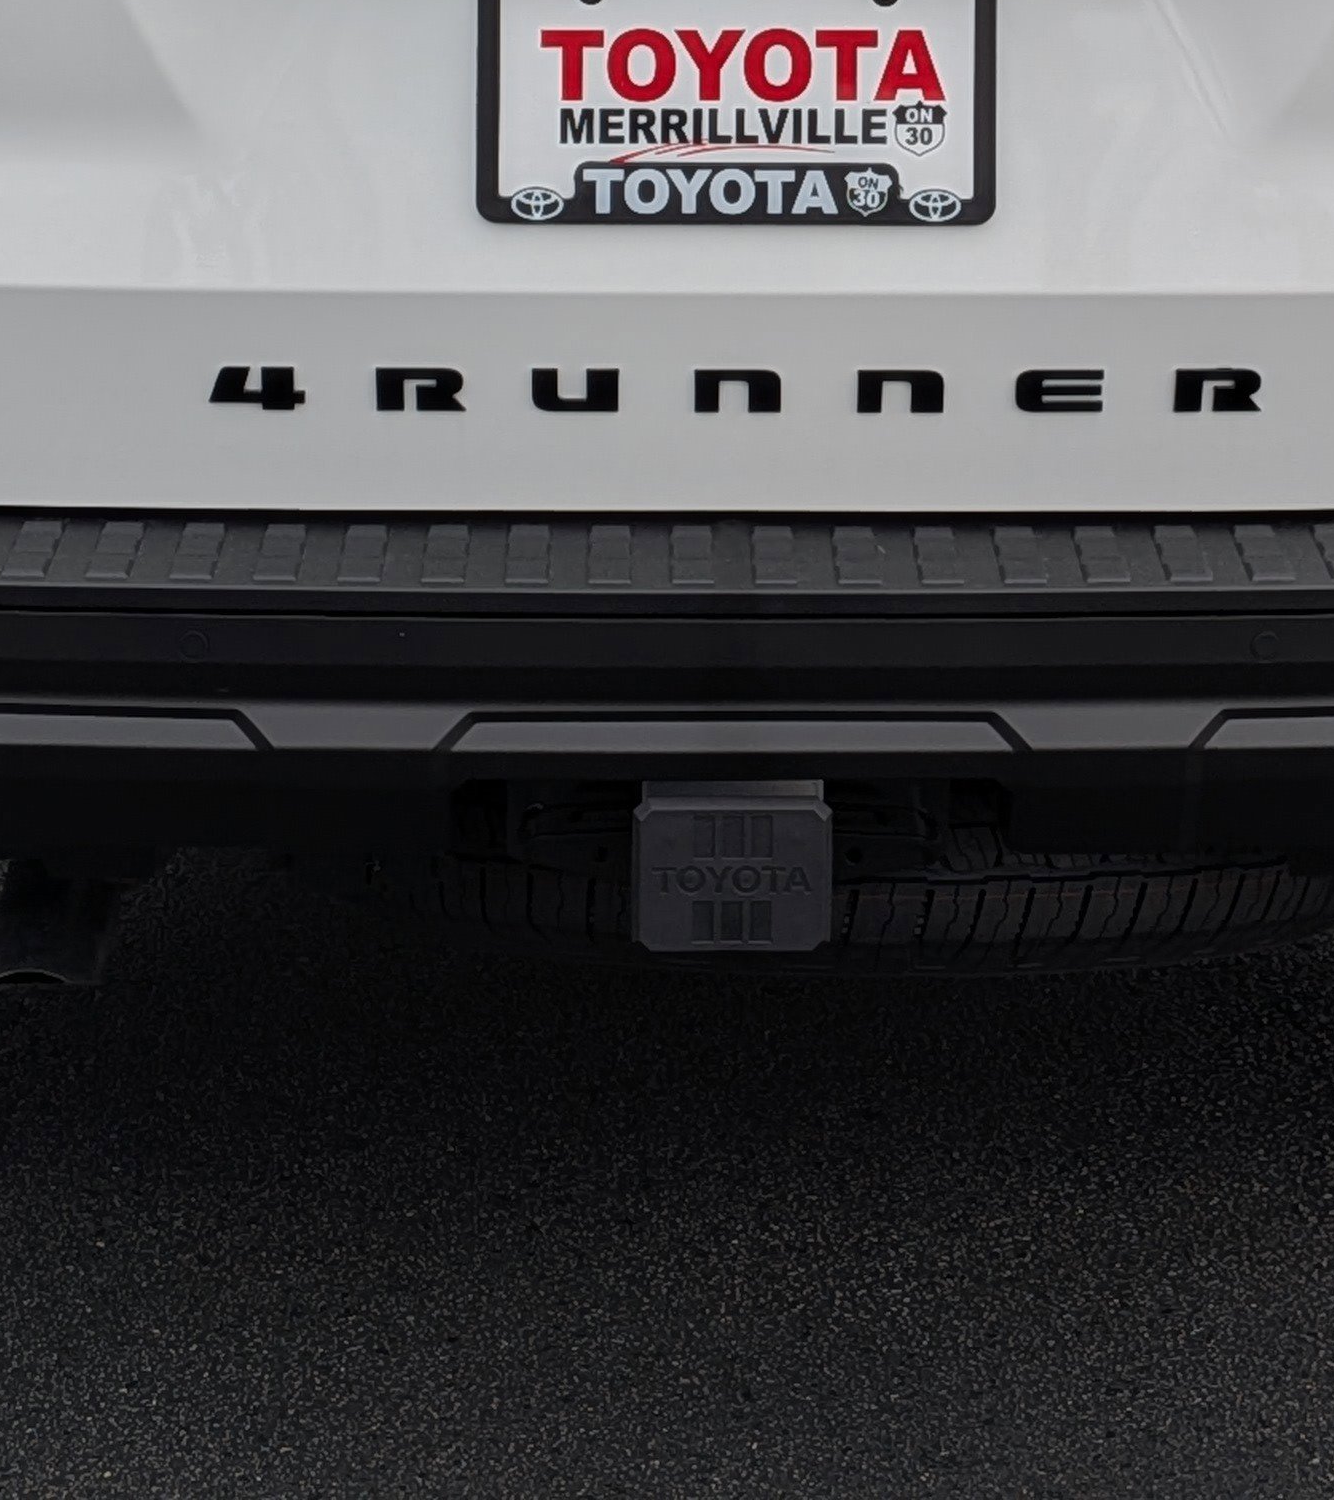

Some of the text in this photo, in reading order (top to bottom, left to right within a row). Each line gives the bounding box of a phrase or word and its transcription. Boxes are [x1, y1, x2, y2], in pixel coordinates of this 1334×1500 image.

[540, 28, 946, 102] TOYOTA
[559, 107, 888, 145] MERRILLVILLE
[904, 106, 933, 124] ON
[904, 126, 933, 147] 30
[582, 169, 839, 216] TOYOTA
[857, 176, 880, 190] ON
[852, 189, 881, 209] 30
[651, 865, 814, 895] TOYOTA
